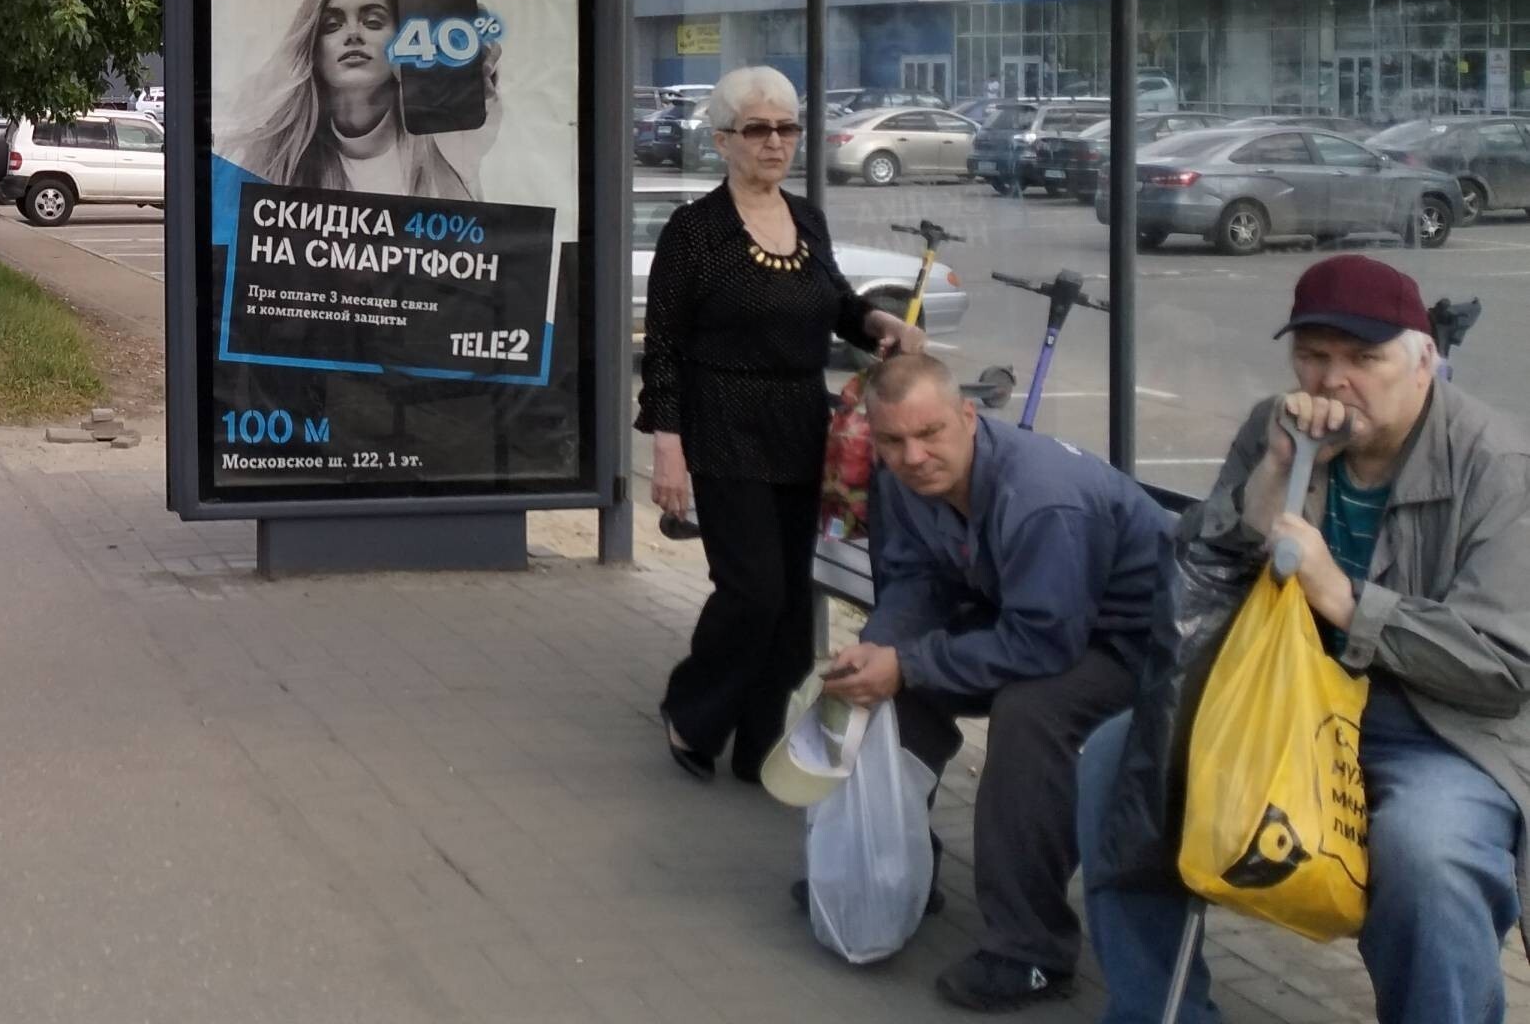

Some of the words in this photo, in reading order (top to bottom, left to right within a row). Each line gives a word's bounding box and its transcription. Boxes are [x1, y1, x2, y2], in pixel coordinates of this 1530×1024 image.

[390, 16, 502, 67] 40%
[252, 198, 395, 239] СКИДКА
[404, 212, 485, 245] 40%
[250, 235, 296, 266] НА
[305, 239, 500, 281] СМАРТФОН
[246, 304, 256, 314] и
[260, 306, 350, 323] комплексной
[354, 313, 407, 326] защиты
[248, 285, 276, 301] При
[280, 290, 326, 303] оплате
[329, 291, 338, 303] 3
[341, 296, 398, 309] месяцев
[401, 300, 439, 312] связи
[450, 329, 530, 361] TELE2
[222, 409, 293, 444] 100
[222, 453, 323, 469] Московское
[328, 458, 347, 468] ш.
[352, 452, 383, 469] 122,
[388, 452, 396, 467] 1
[401, 457, 423, 467] эт.
